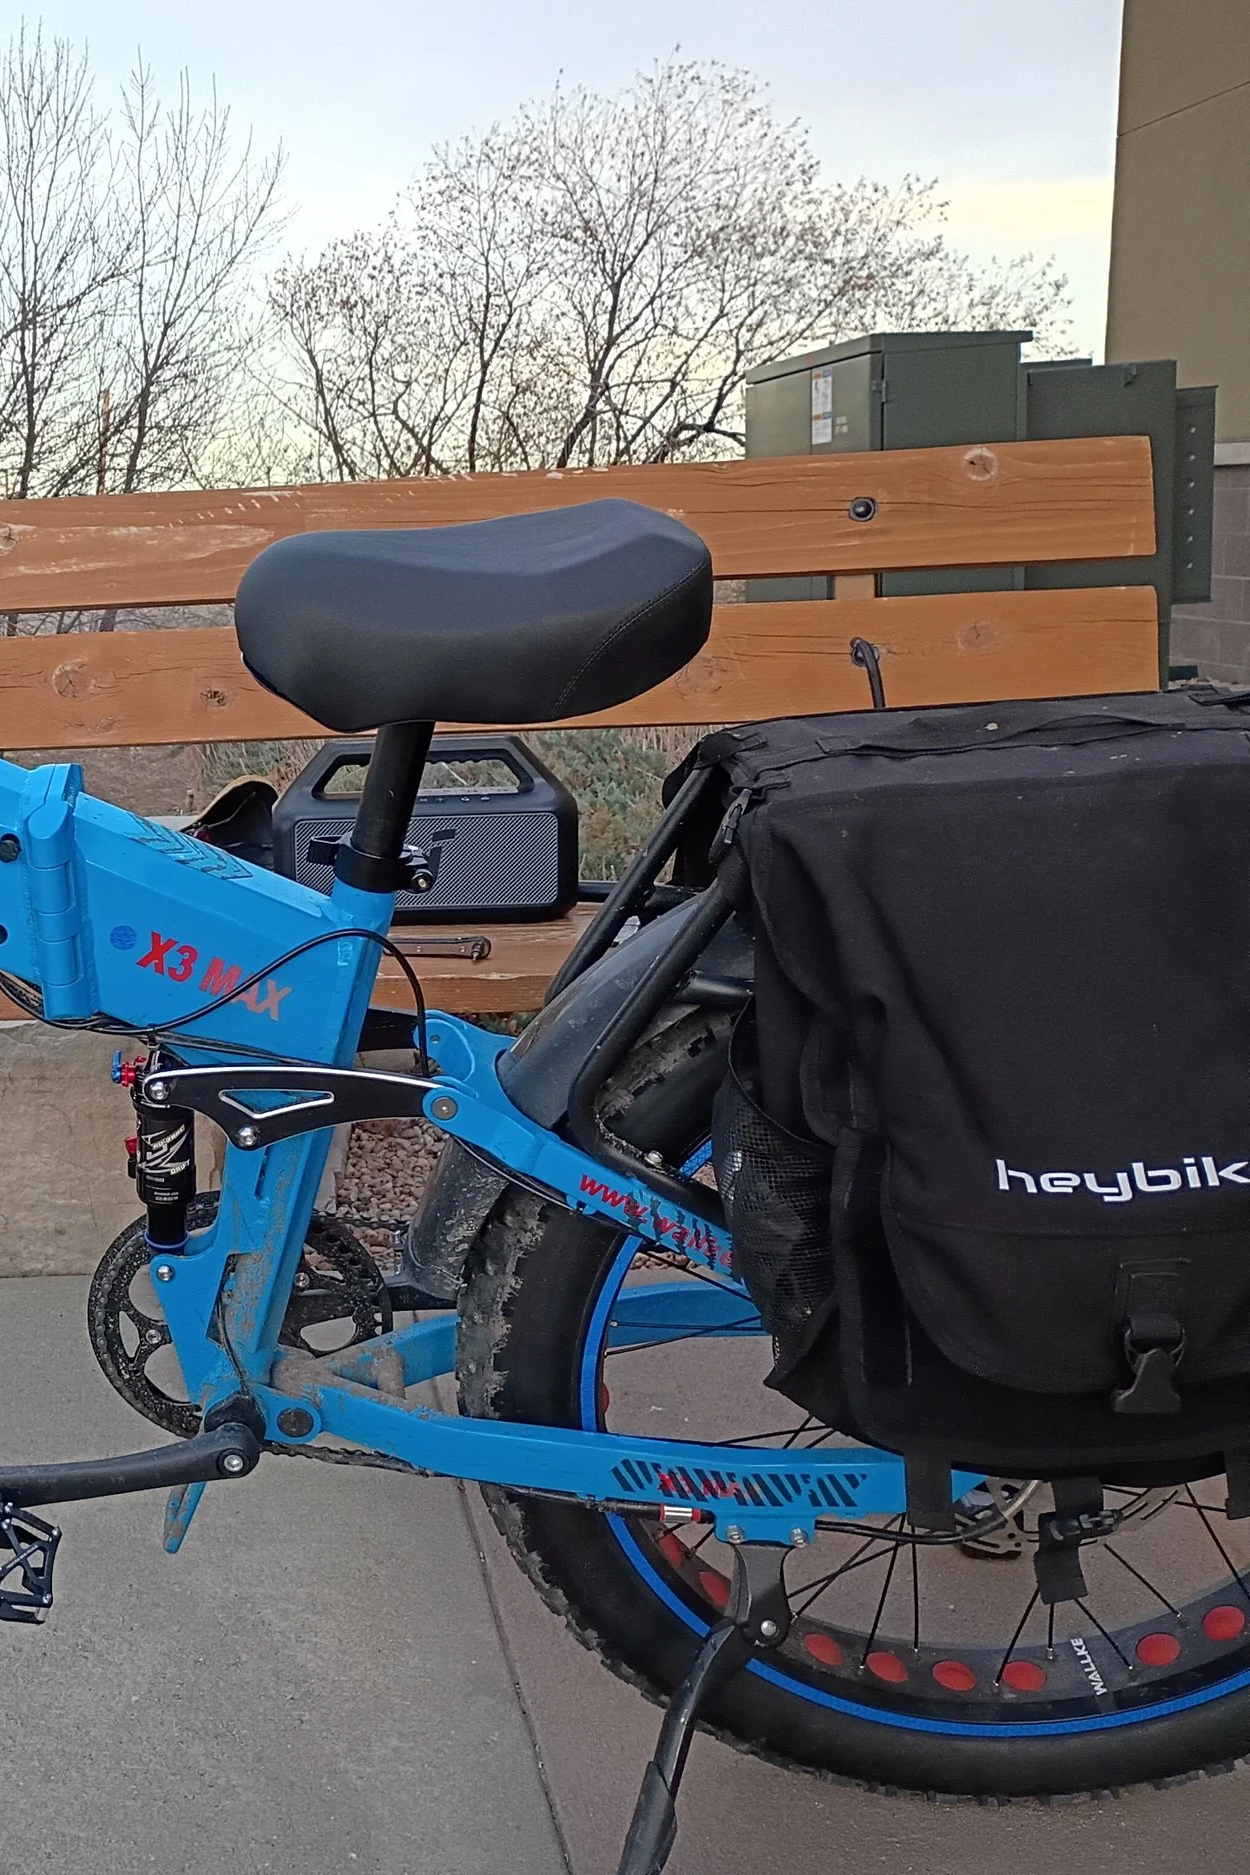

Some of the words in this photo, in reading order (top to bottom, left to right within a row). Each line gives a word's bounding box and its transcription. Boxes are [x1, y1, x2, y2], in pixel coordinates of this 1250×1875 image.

[136, 930, 199, 983] X3
[198, 957, 293, 1022] MAX
[995, 1156, 1250, 1202] heybik
[1070, 1637, 1109, 1696] WALLKE
